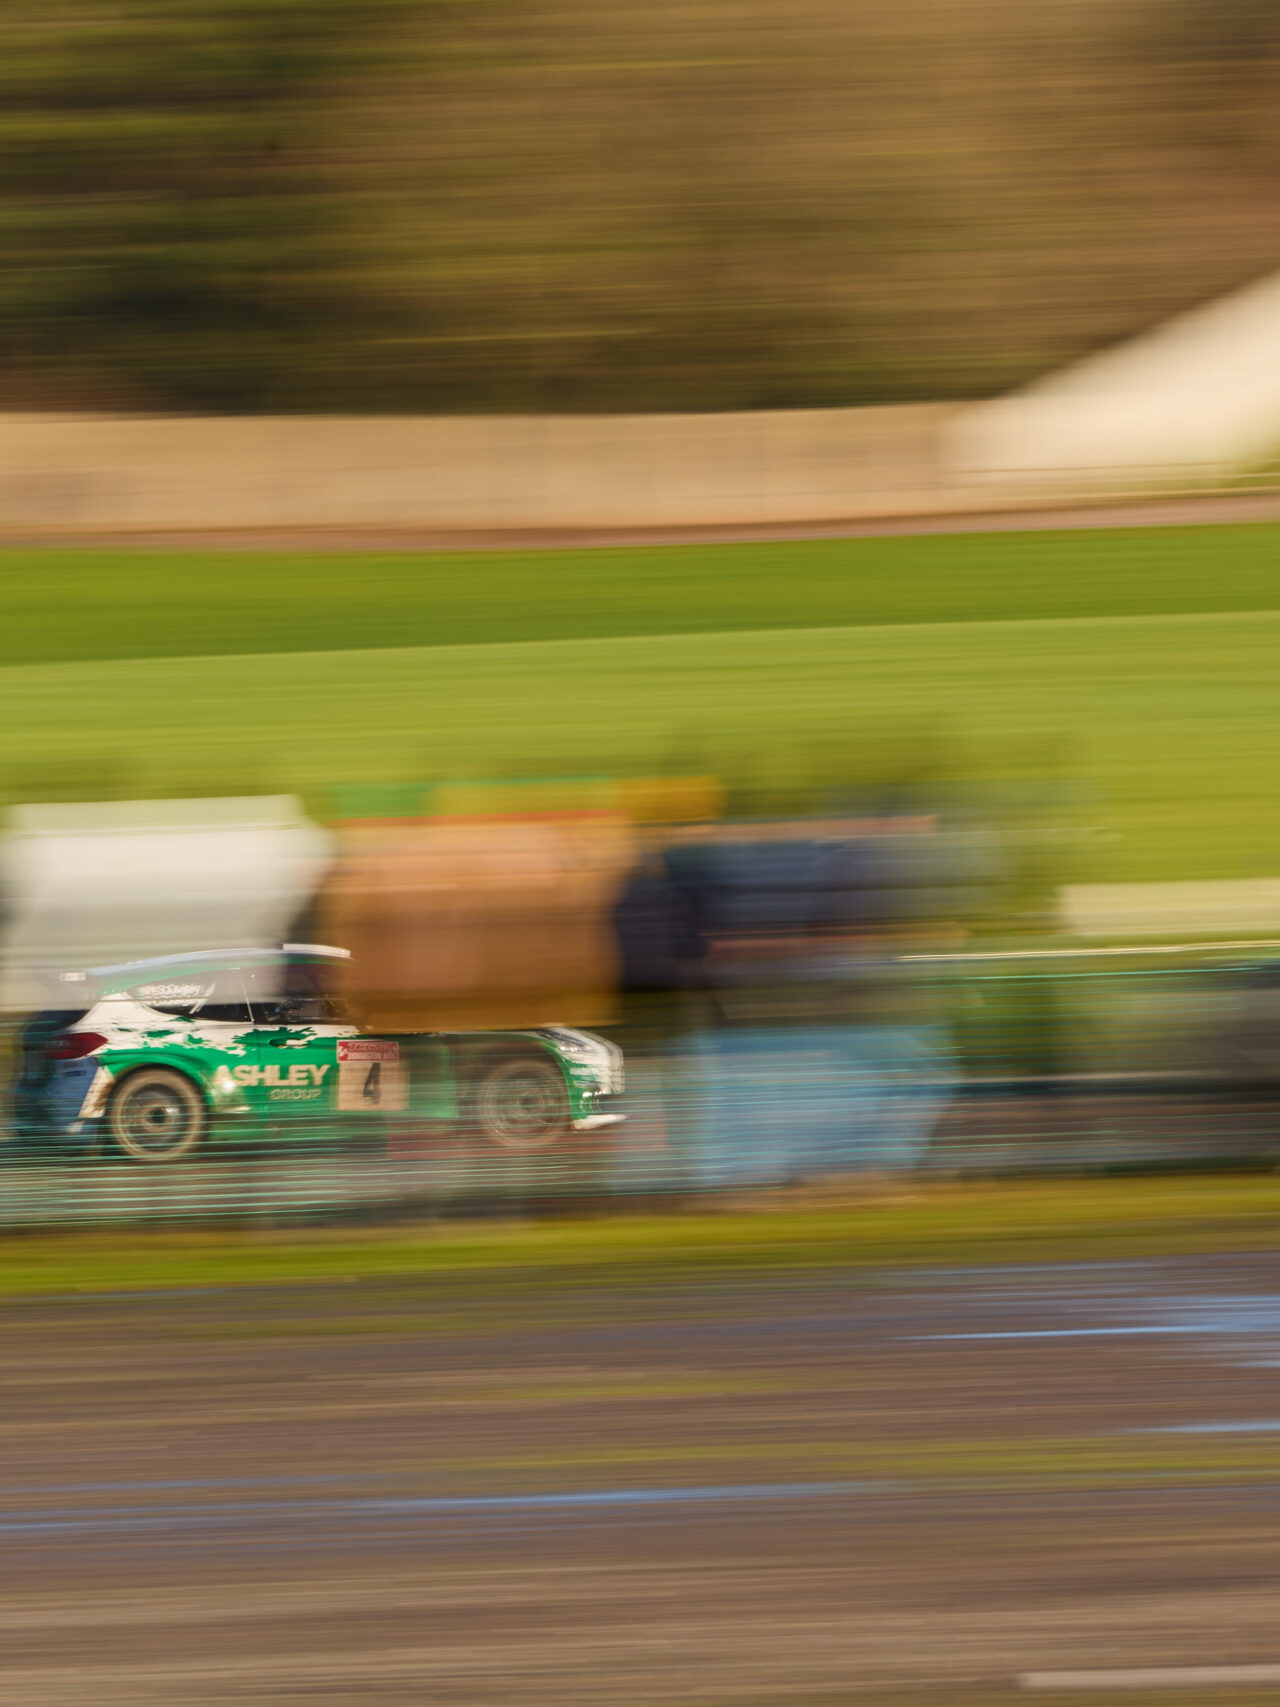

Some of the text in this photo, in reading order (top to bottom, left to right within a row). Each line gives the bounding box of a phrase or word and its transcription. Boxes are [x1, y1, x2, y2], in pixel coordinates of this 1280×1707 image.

[213, 1064, 330, 1087] ASHLEY
[363, 1062, 381, 1105] 4
[270, 1089, 321, 1100] GROUP
